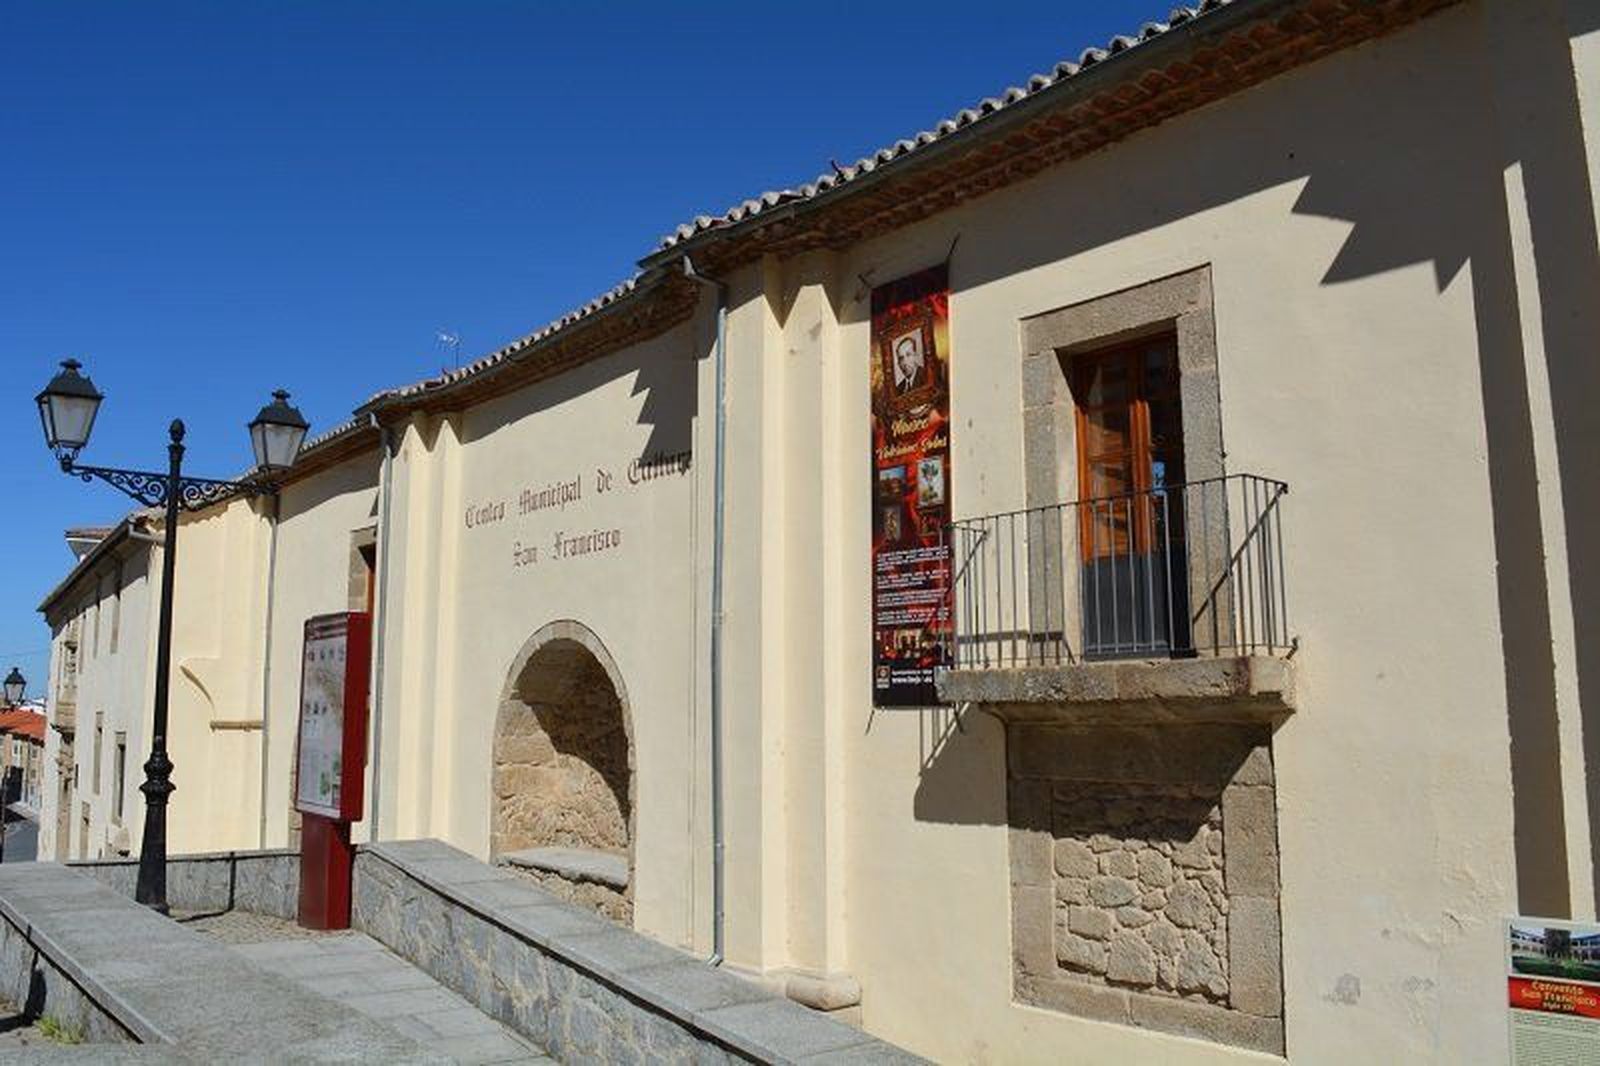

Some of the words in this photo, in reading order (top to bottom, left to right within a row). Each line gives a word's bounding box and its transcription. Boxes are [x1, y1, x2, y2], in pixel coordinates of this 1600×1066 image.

[465, 502, 505, 529] Centro
[519, 475, 582, 515] Municipal
[597, 469, 613, 493] de
[627, 451, 693, 485] Cultura
[513, 541, 538, 567] San
[553, 528, 621, 560] Francisco
